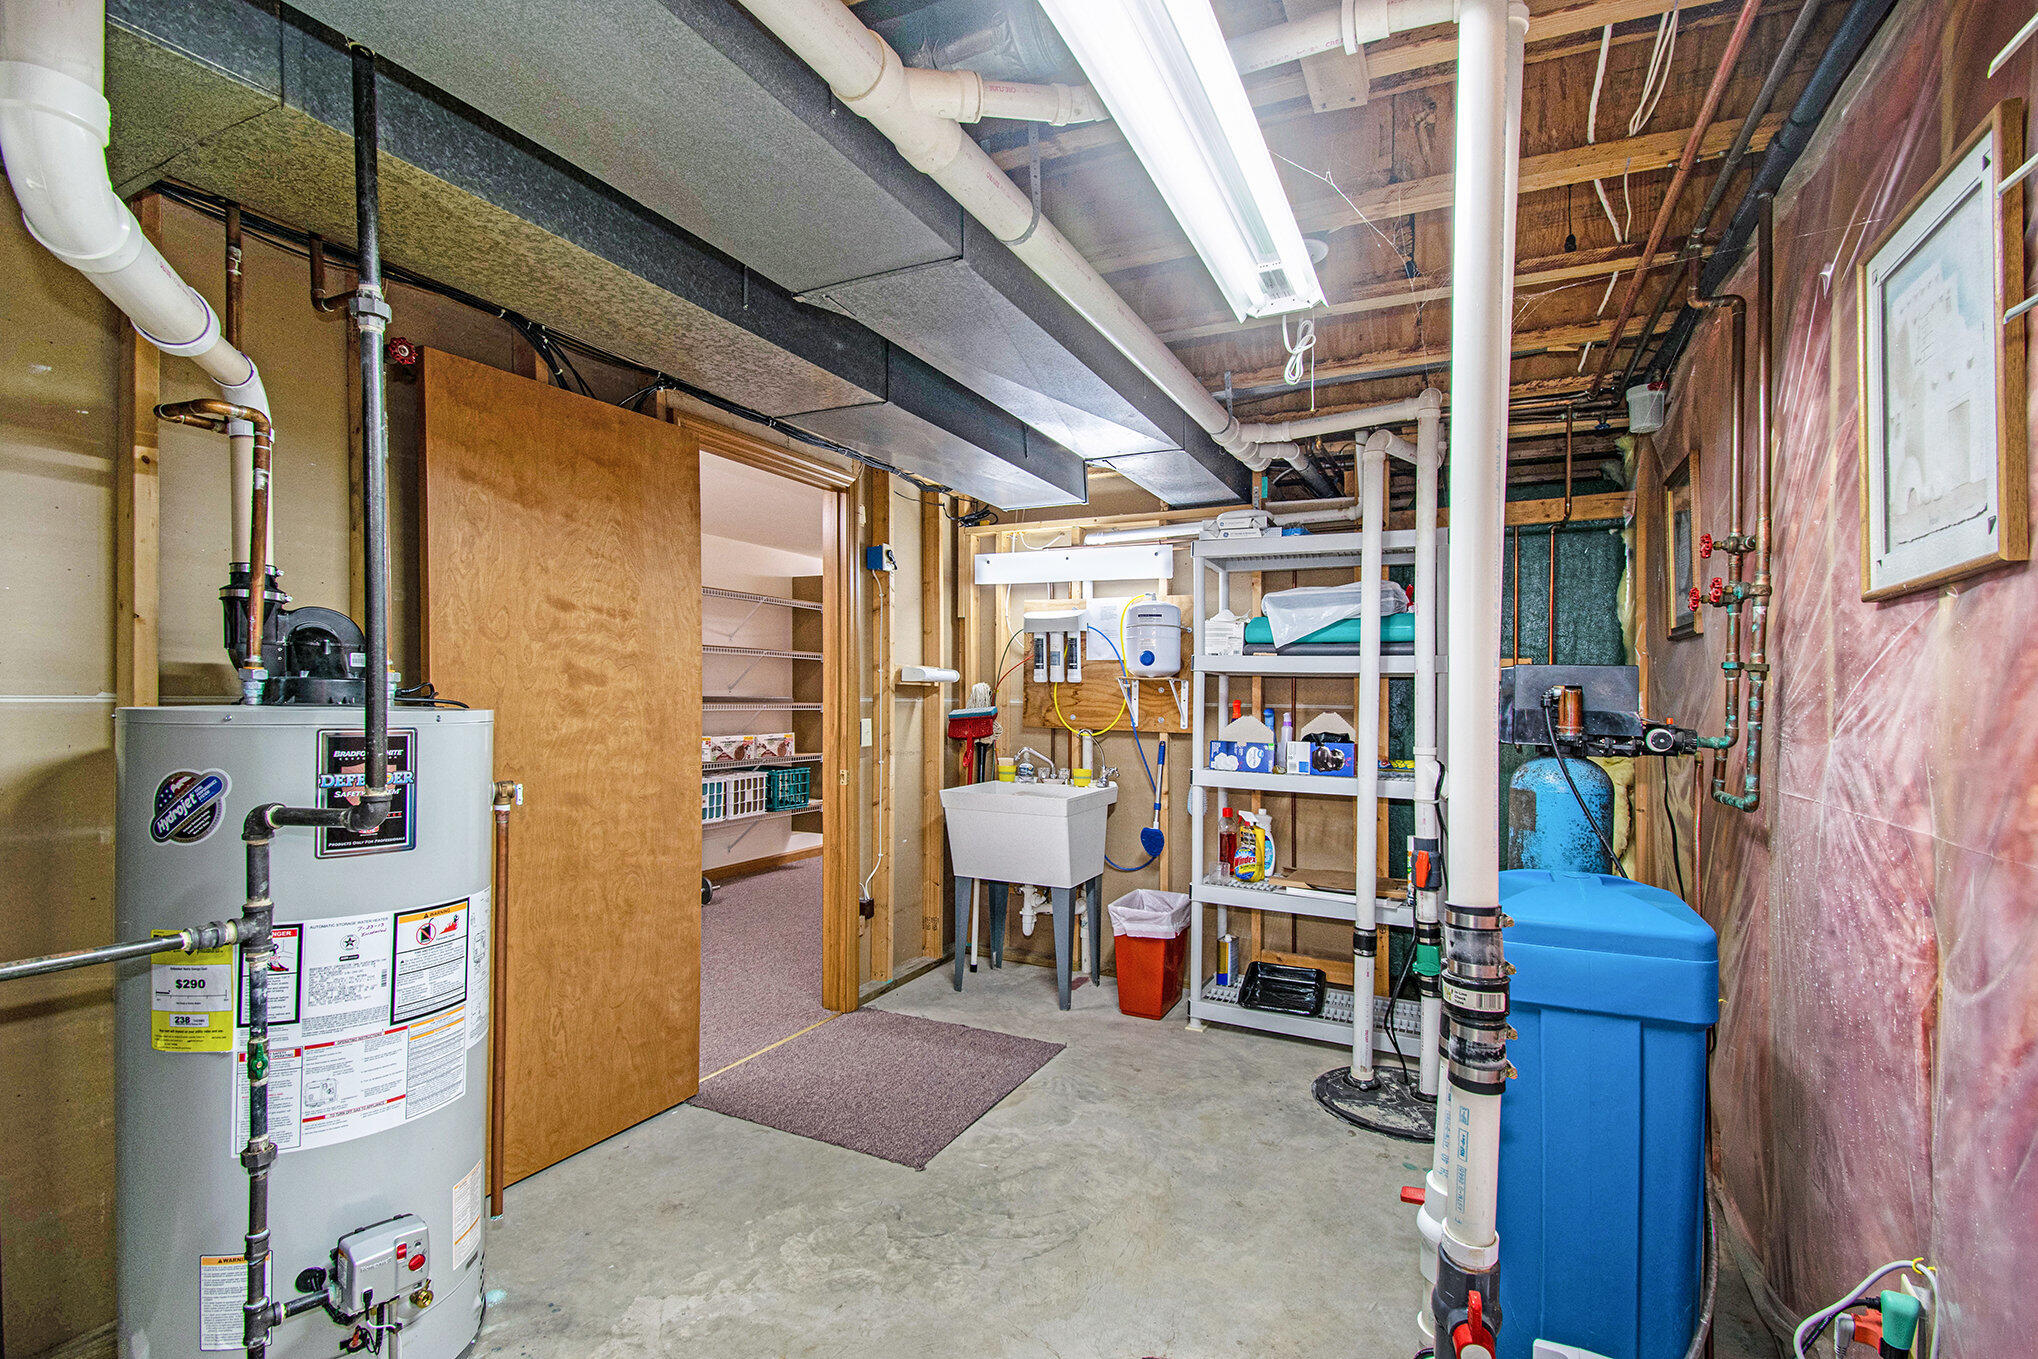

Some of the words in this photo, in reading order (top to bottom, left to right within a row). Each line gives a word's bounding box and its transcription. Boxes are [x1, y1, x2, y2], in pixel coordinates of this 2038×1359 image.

[320, 771, 415, 788] DEFEDER
[157, 793, 198, 834] Hydrojet
[1234, 856, 1256, 868] Windex
[175, 979, 206, 989] $290
[174, 1016, 191, 1025] 238
